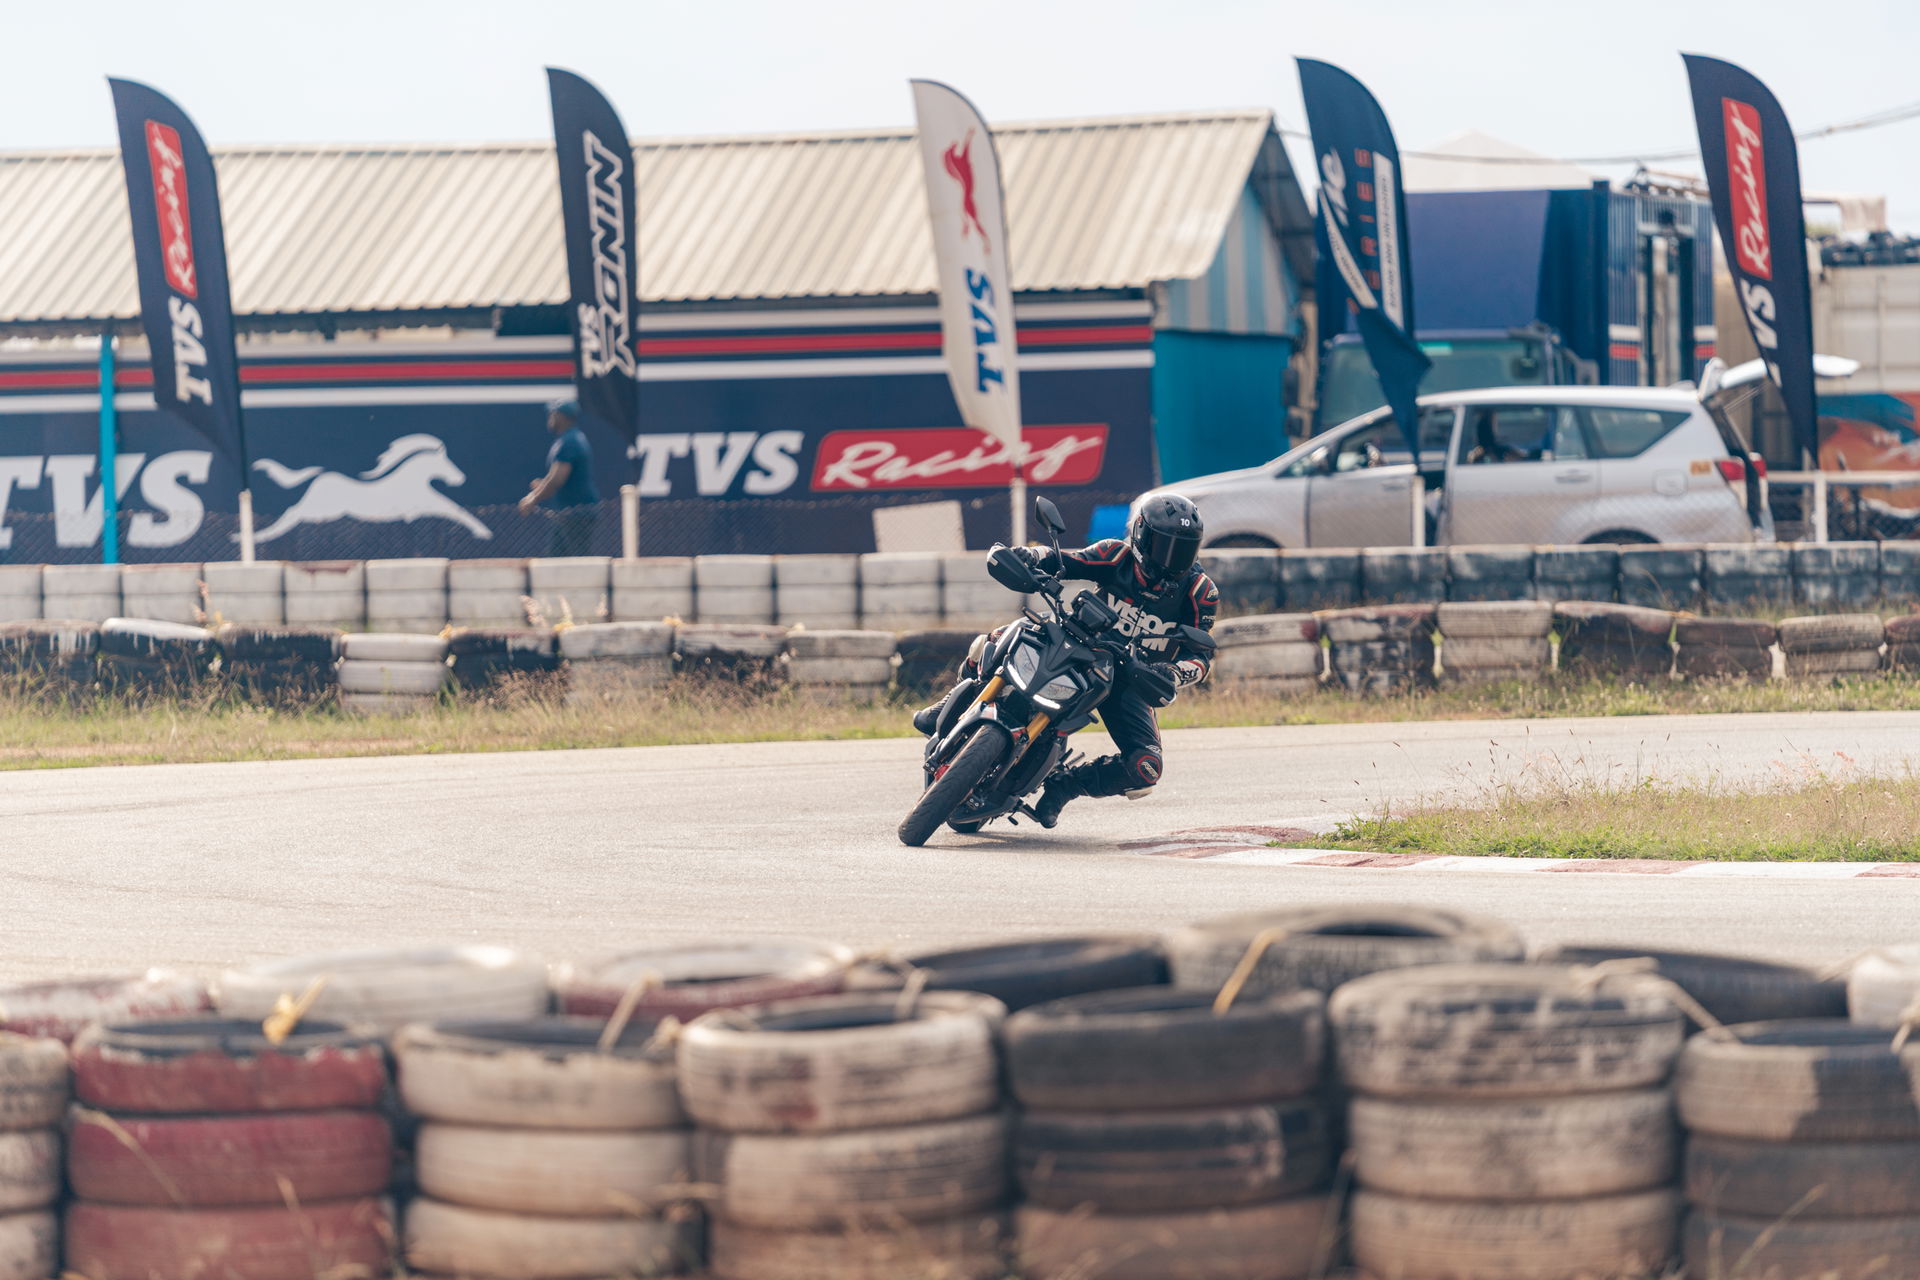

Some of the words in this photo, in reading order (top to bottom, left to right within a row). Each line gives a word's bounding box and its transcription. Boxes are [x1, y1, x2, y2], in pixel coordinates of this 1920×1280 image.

[152, 122, 194, 292] Racing
[1730, 102, 1770, 273] Racing
[583, 129, 637, 378] RONIN
[168, 295, 213, 406] TVS
[578, 302, 602, 378] TVS
[964, 266, 1003, 392] TVS
[1741, 278, 1782, 388] VS
[628, 431, 804, 497] TVS
[822, 436, 1101, 487] Racing
[1180, 518, 1190, 527] 10
